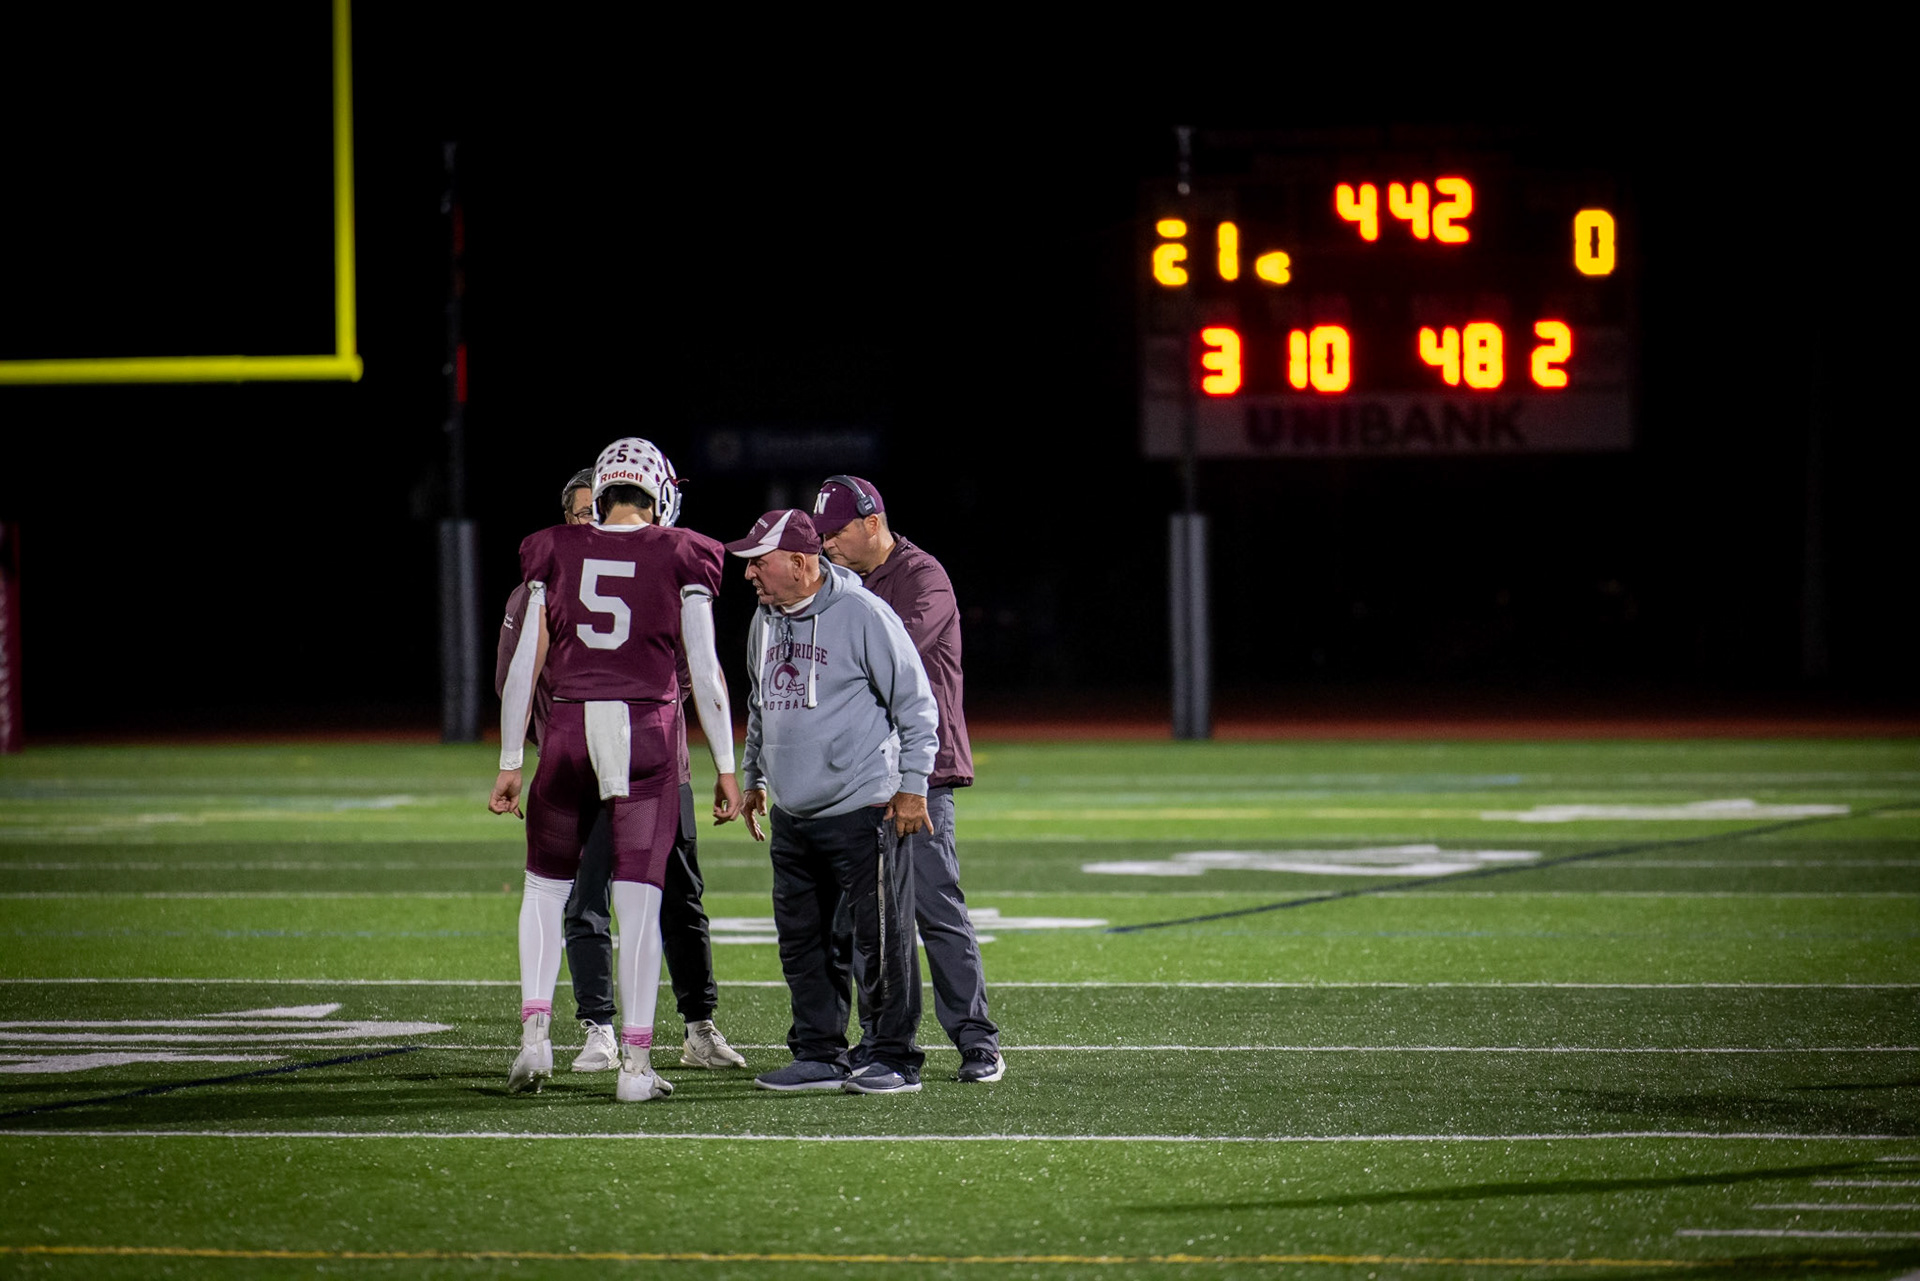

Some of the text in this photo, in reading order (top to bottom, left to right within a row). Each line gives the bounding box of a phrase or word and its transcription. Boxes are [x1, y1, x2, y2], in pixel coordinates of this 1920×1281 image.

[1573, 207, 1617, 277] 0
[1200, 319, 1574, 397] 3 10 48 2
[1245, 400, 1527, 449] UNIBANK
[616, 449, 629, 463] 5
[813, 492, 831, 515] N
[576, 558, 637, 651] 5
